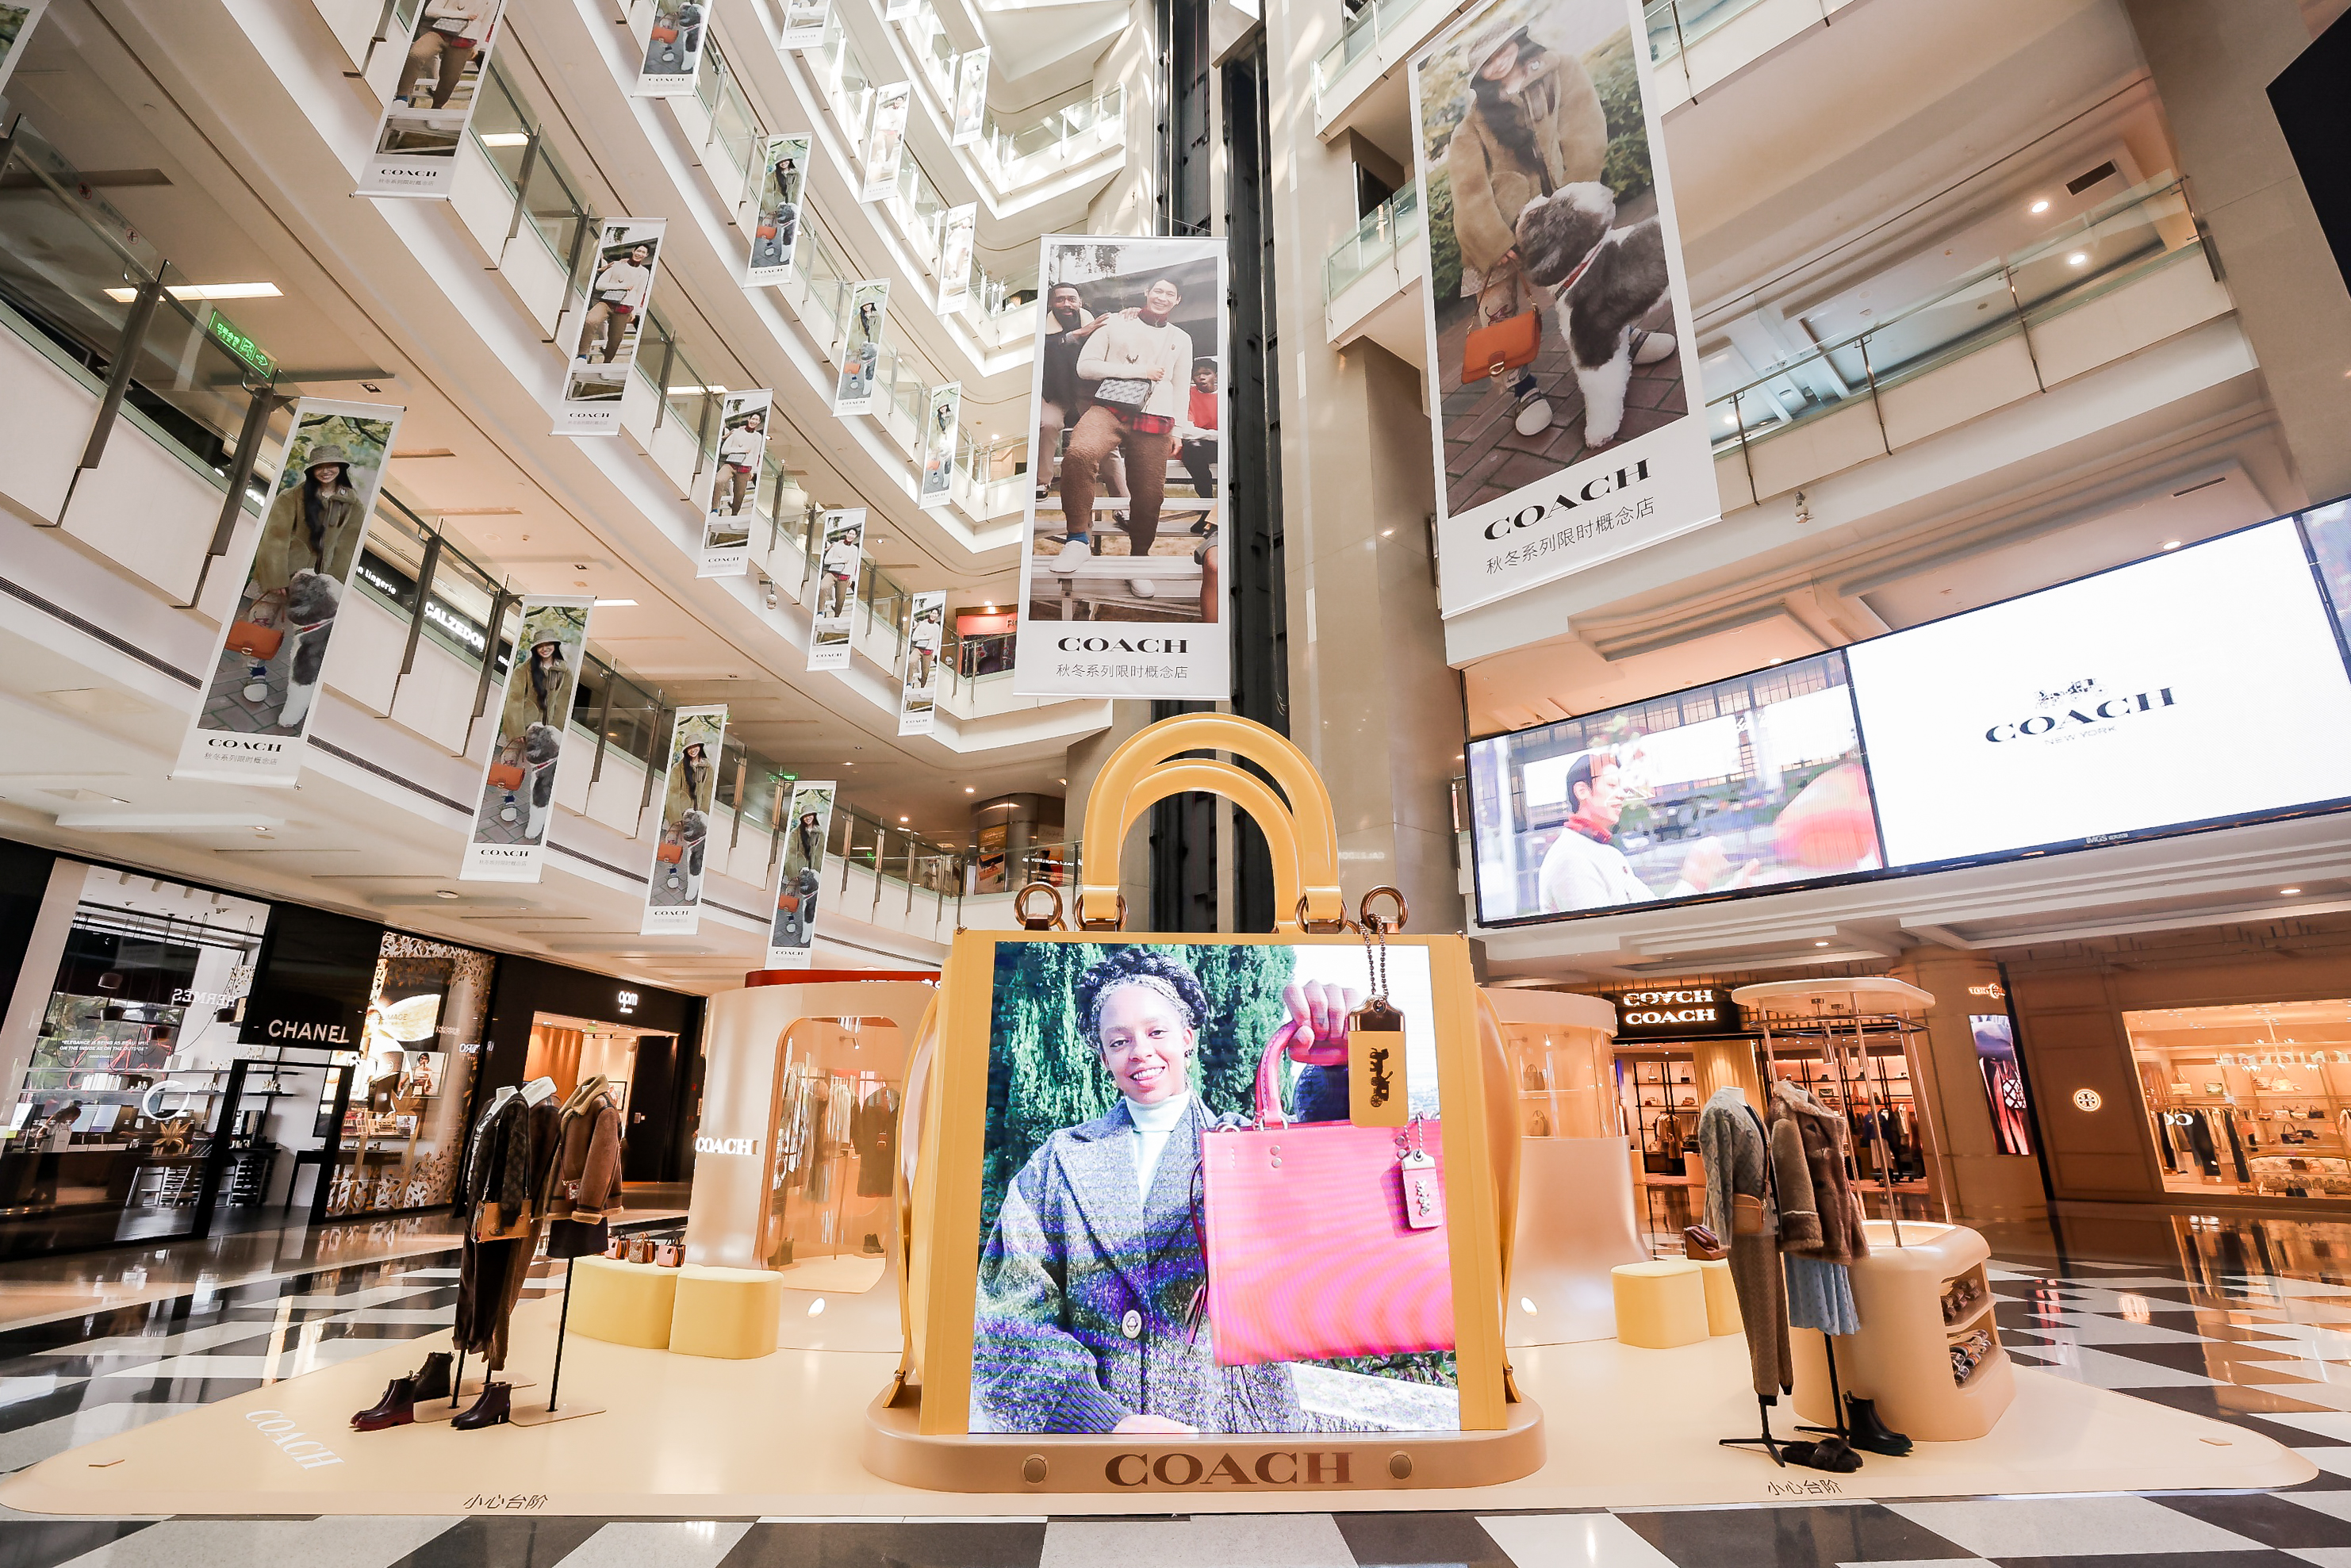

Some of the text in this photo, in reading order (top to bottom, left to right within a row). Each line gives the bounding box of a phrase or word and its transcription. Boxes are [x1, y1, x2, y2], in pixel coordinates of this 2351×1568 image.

[1483, 458, 1651, 541] COACH
[1486, 496, 1655, 576] 秋冬系列限时概念店
[365, 569, 397, 595] lingerie
[1057, 637, 1190, 654] COACH
[1056, 663, 1188, 680] 秋冬系列限时概念店
[1985, 686, 2177, 742] COACH
[2044, 726, 2116, 745] NEW YORK
[208, 738, 282, 753] COACH
[203, 752, 279, 765] 秋冬系列限时概念店
[1625, 1009, 1716, 1025] COACH
[268, 1019, 350, 1043] CHANEL
[695, 1137, 757, 1156] COACH
[245, 1409, 345, 1470] COACH
[1105, 1451, 1353, 1486] COACH
[1767, 1478, 1843, 1496] 小心台阶
[463, 1493, 549, 1510] 小心台阶
